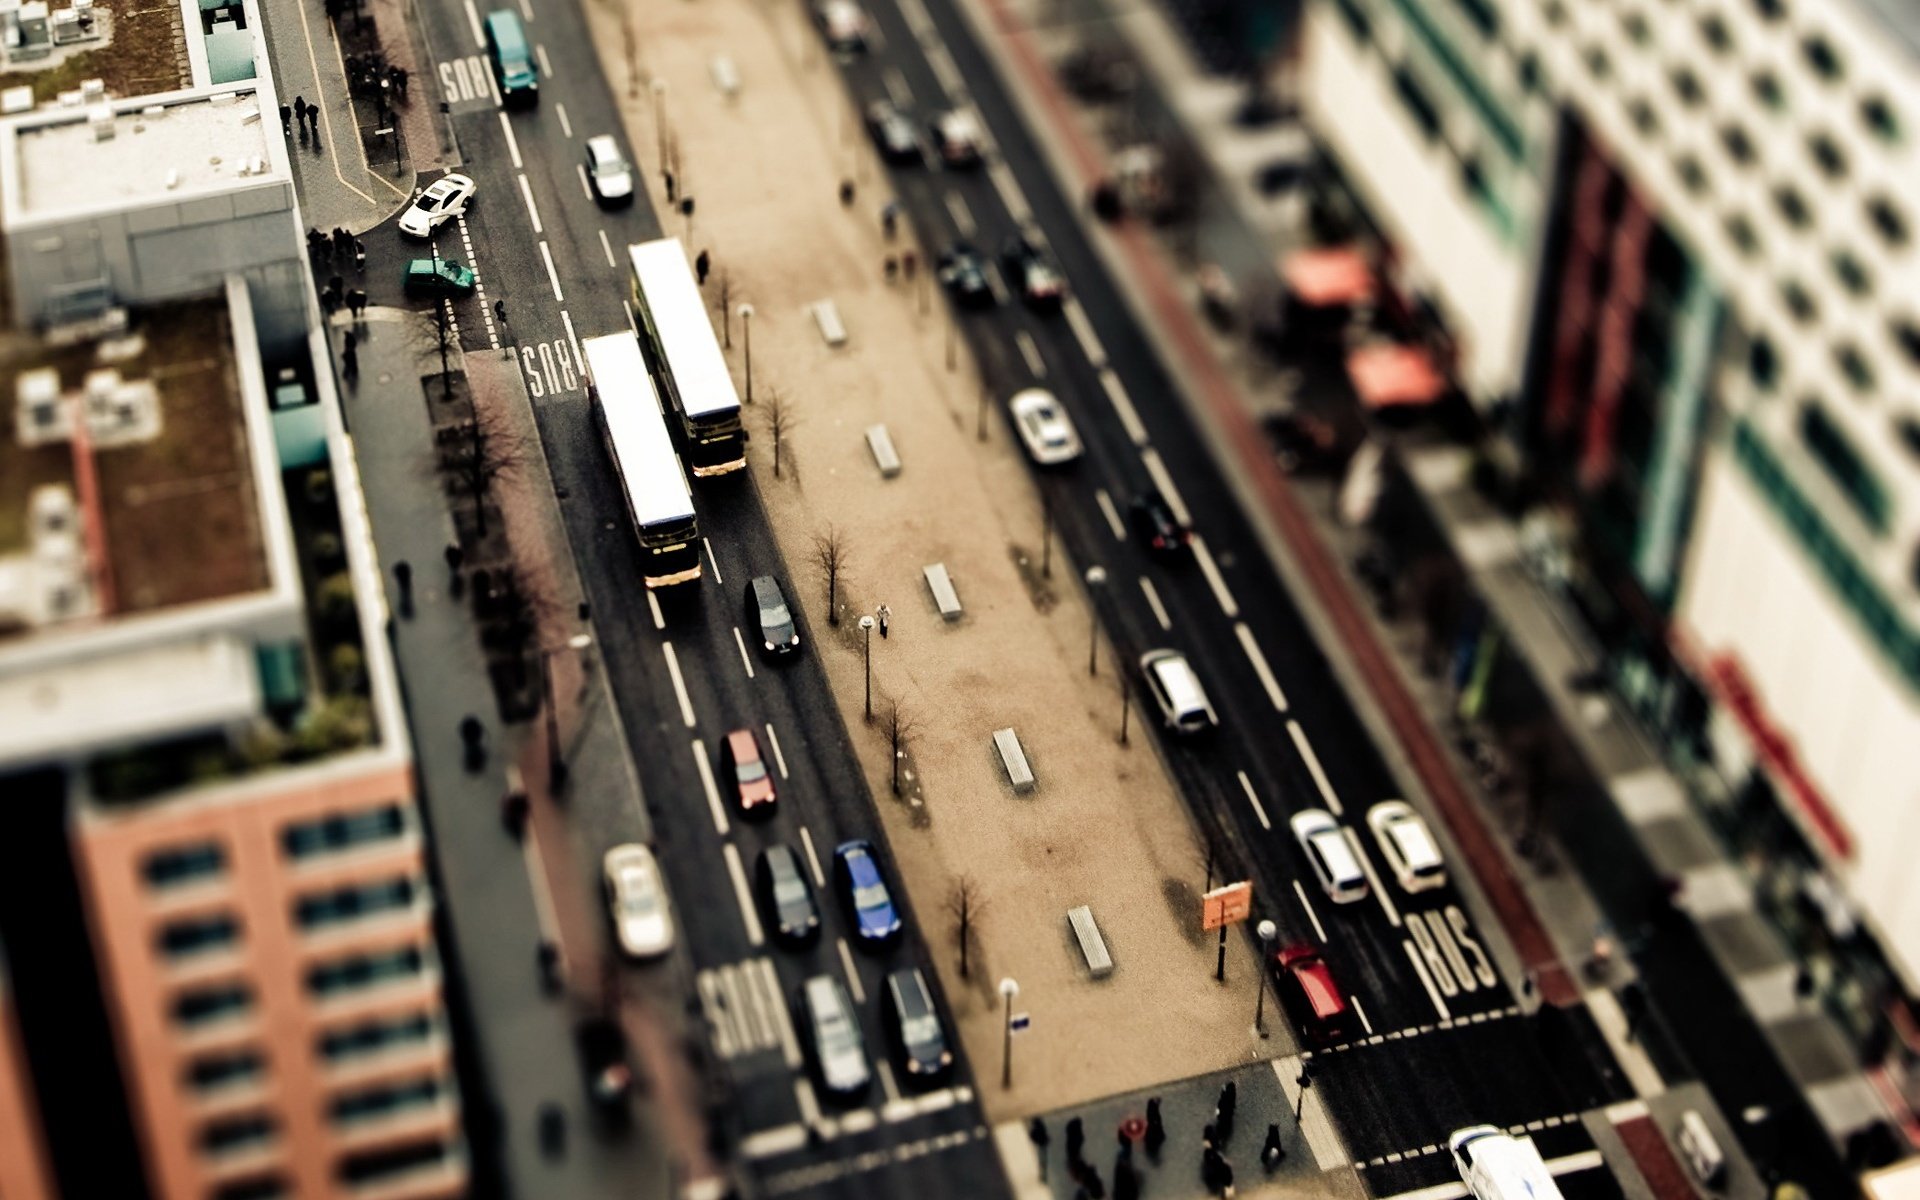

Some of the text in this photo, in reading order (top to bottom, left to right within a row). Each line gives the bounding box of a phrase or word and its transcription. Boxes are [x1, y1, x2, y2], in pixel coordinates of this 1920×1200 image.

[439, 55, 489, 103] BUS
[522, 339, 578, 397] BUS
[1404, 905, 1496, 996] BUS
